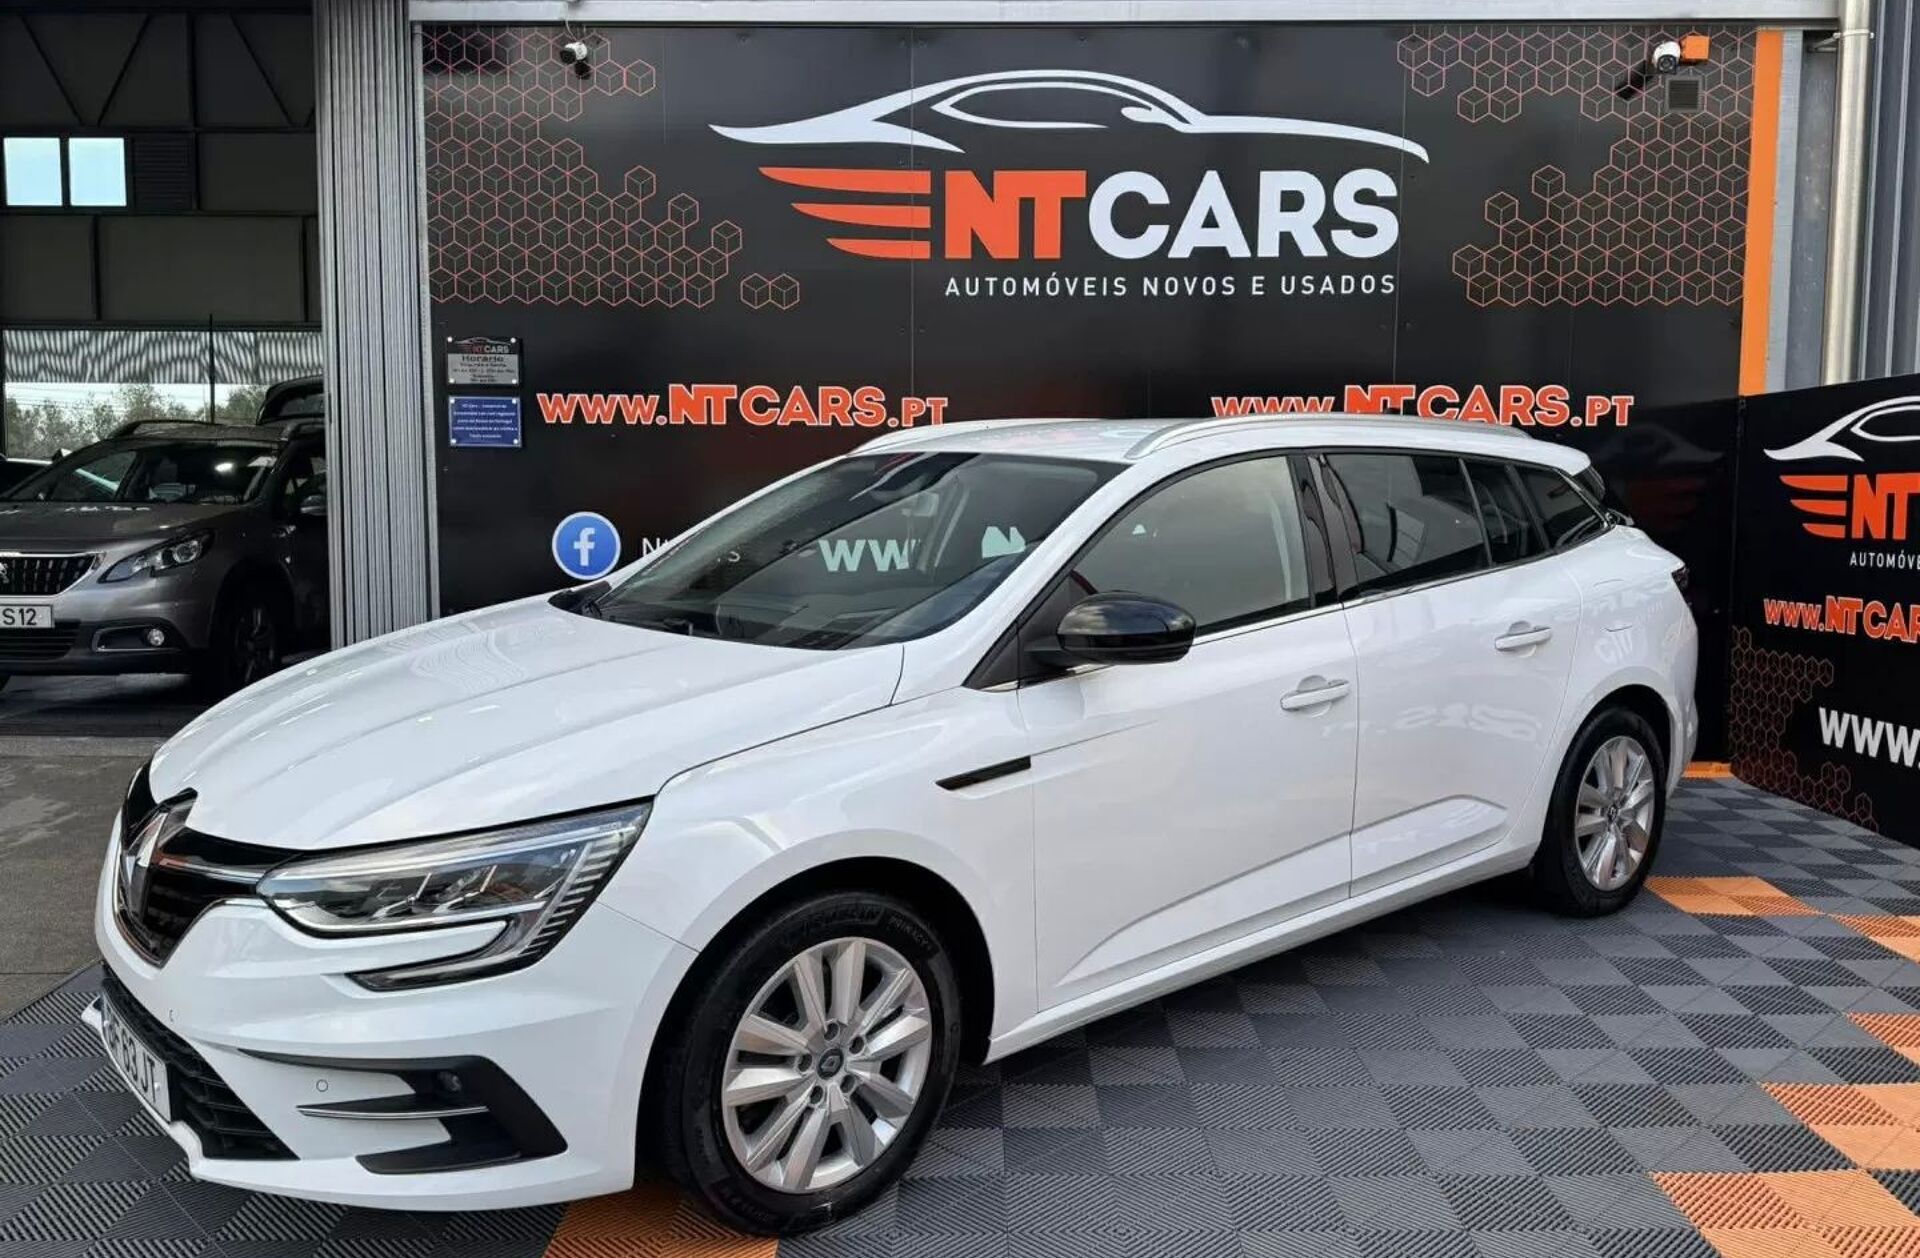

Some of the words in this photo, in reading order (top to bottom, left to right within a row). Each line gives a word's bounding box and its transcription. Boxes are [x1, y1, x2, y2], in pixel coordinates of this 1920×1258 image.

[944, 168, 1399, 260] NTCARS
[944, 272, 1127, 297] AUTOMÓVEIS
[1143, 276, 1236, 296] NOVOS
[1251, 276, 1265, 295] E
[1280, 274, 1396, 295] USADOS
[1819, 706, 1920, 768] WWW
